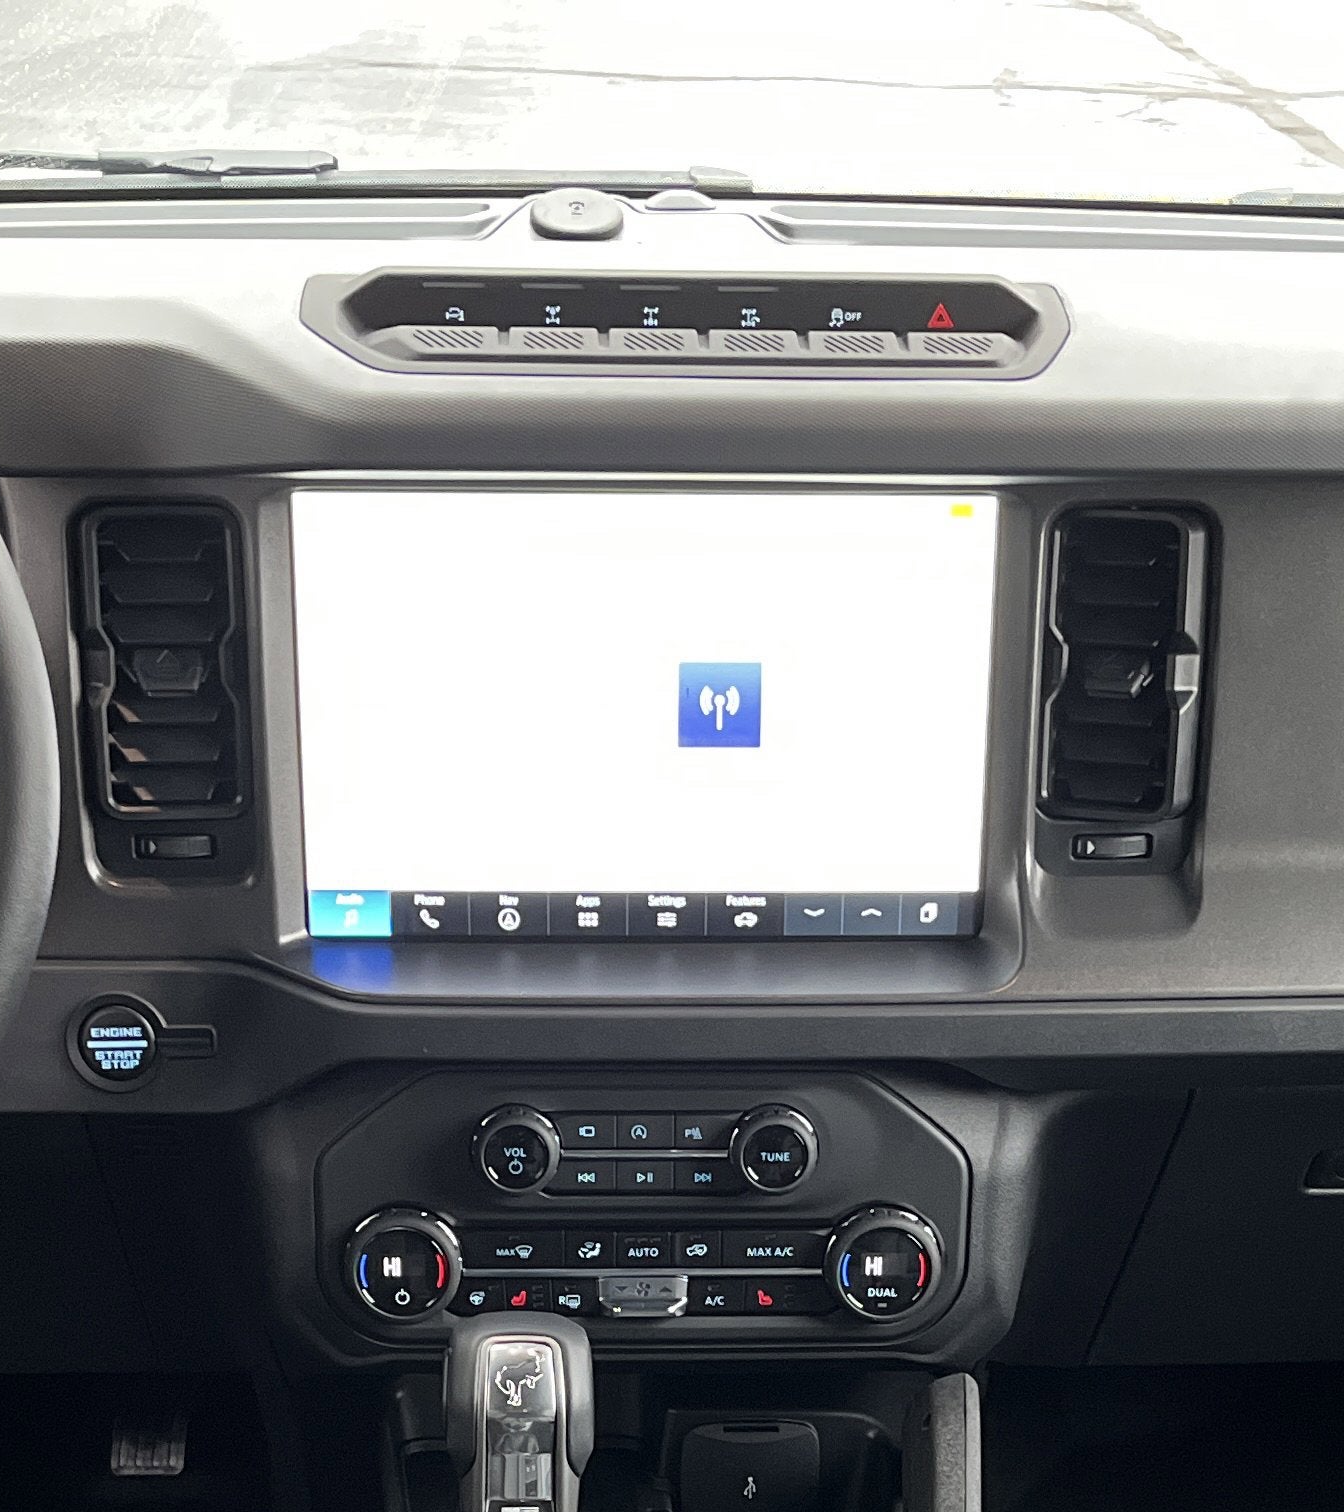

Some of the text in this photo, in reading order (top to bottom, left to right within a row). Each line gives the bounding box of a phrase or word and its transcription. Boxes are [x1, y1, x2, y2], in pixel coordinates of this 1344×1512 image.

[844, 312, 862, 321] OFF
[414, 894, 445, 906] Phone
[499, 894, 519, 906] Nav
[647, 895, 687, 908] Settings
[725, 894, 766, 907] Features
[90, 1027, 142, 1037] ENGINE
[95, 1050, 143, 1060] START
[101, 1060, 139, 1069] STOP
[504, 1147, 526, 1157] VOL
[761, 1151, 791, 1162] TUNE
[627, 1247, 659, 1257] AUTO
[746, 1246, 794, 1257] MAX A/C
[383, 1256, 402, 1277] HI
[865, 1256, 883, 1277] HI
[867, 1287, 898, 1297] DUAL
[705, 1296, 725, 1306] A/C
